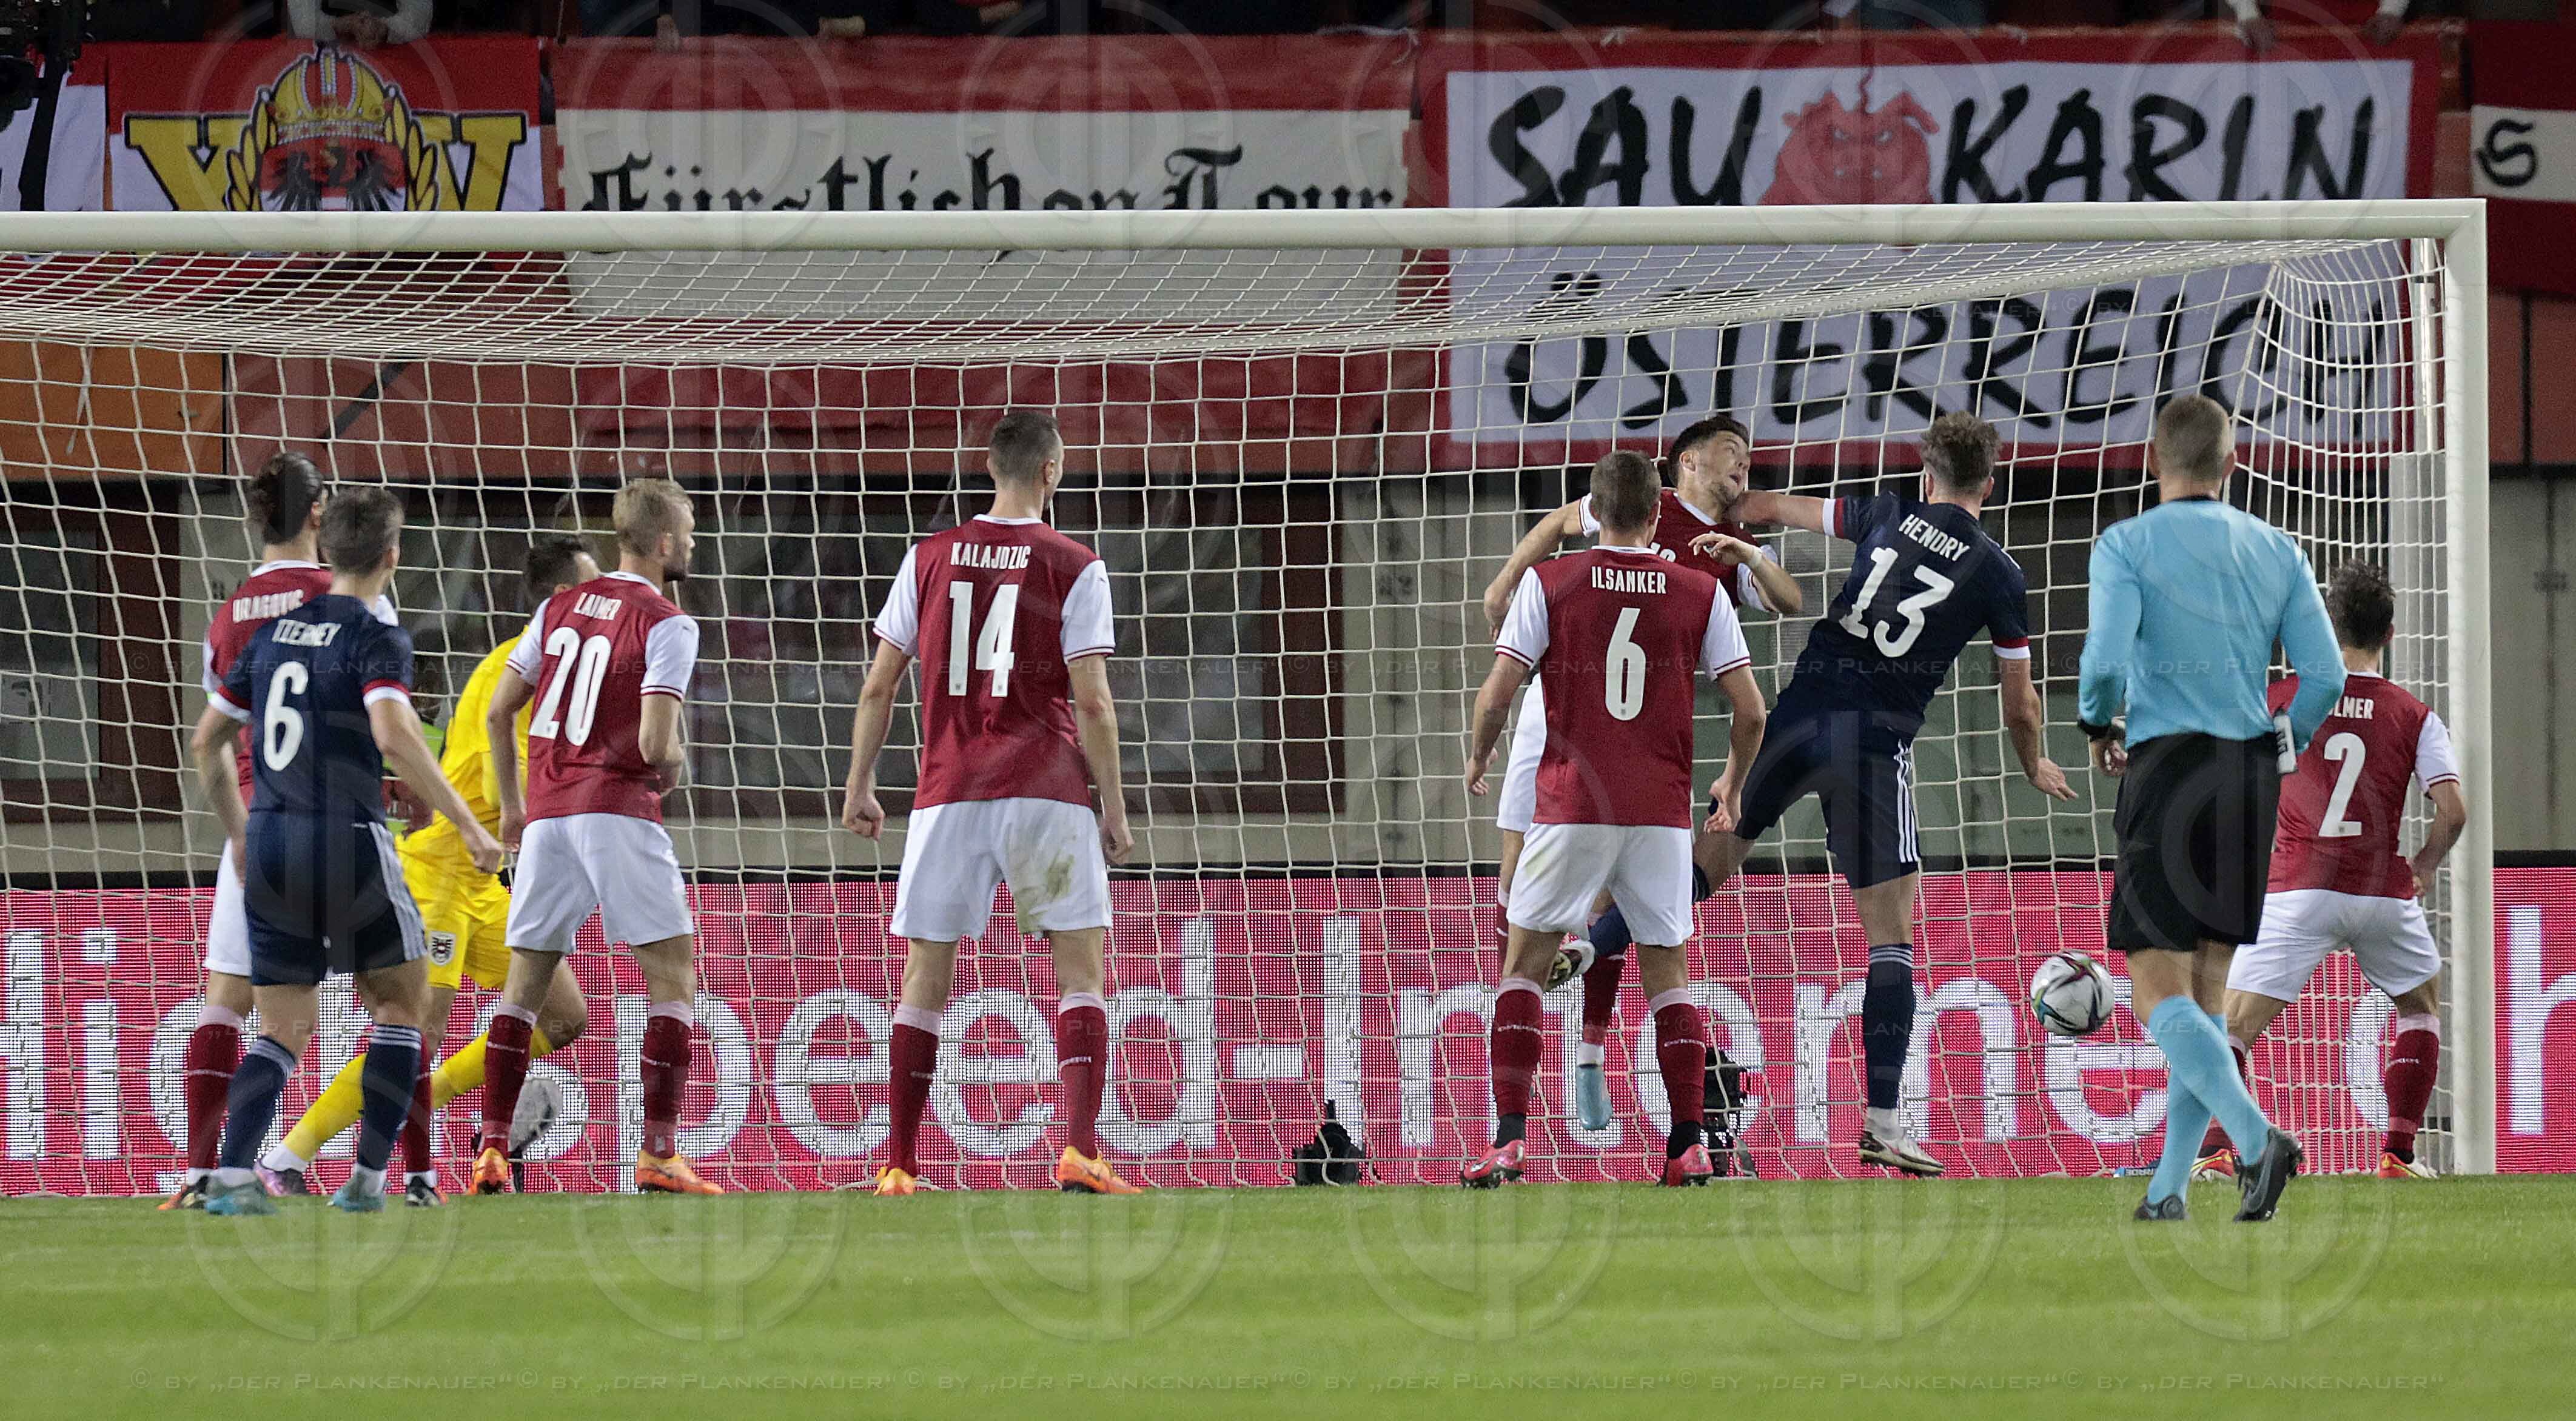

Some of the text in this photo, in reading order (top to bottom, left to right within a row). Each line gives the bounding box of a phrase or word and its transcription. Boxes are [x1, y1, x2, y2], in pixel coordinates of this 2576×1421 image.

[1488, 85, 1763, 207] SAU
[1942, 83, 2374, 205] KARIN
[1504, 271, 2385, 436] ÖSTERREICH
[950, 541, 1031, 570] KALAJDZIC
[1591, 566, 1666, 594] ILSANKER
[1898, 513, 1970, 563] HENDRY
[949, 580, 1019, 697] 14
[1839, 546, 1955, 658] 13
[263, 661, 310, 772] 6
[529, 626, 611, 747] 20
[1605, 607, 1647, 721] 6
[2318, 732, 2366, 837] 2
